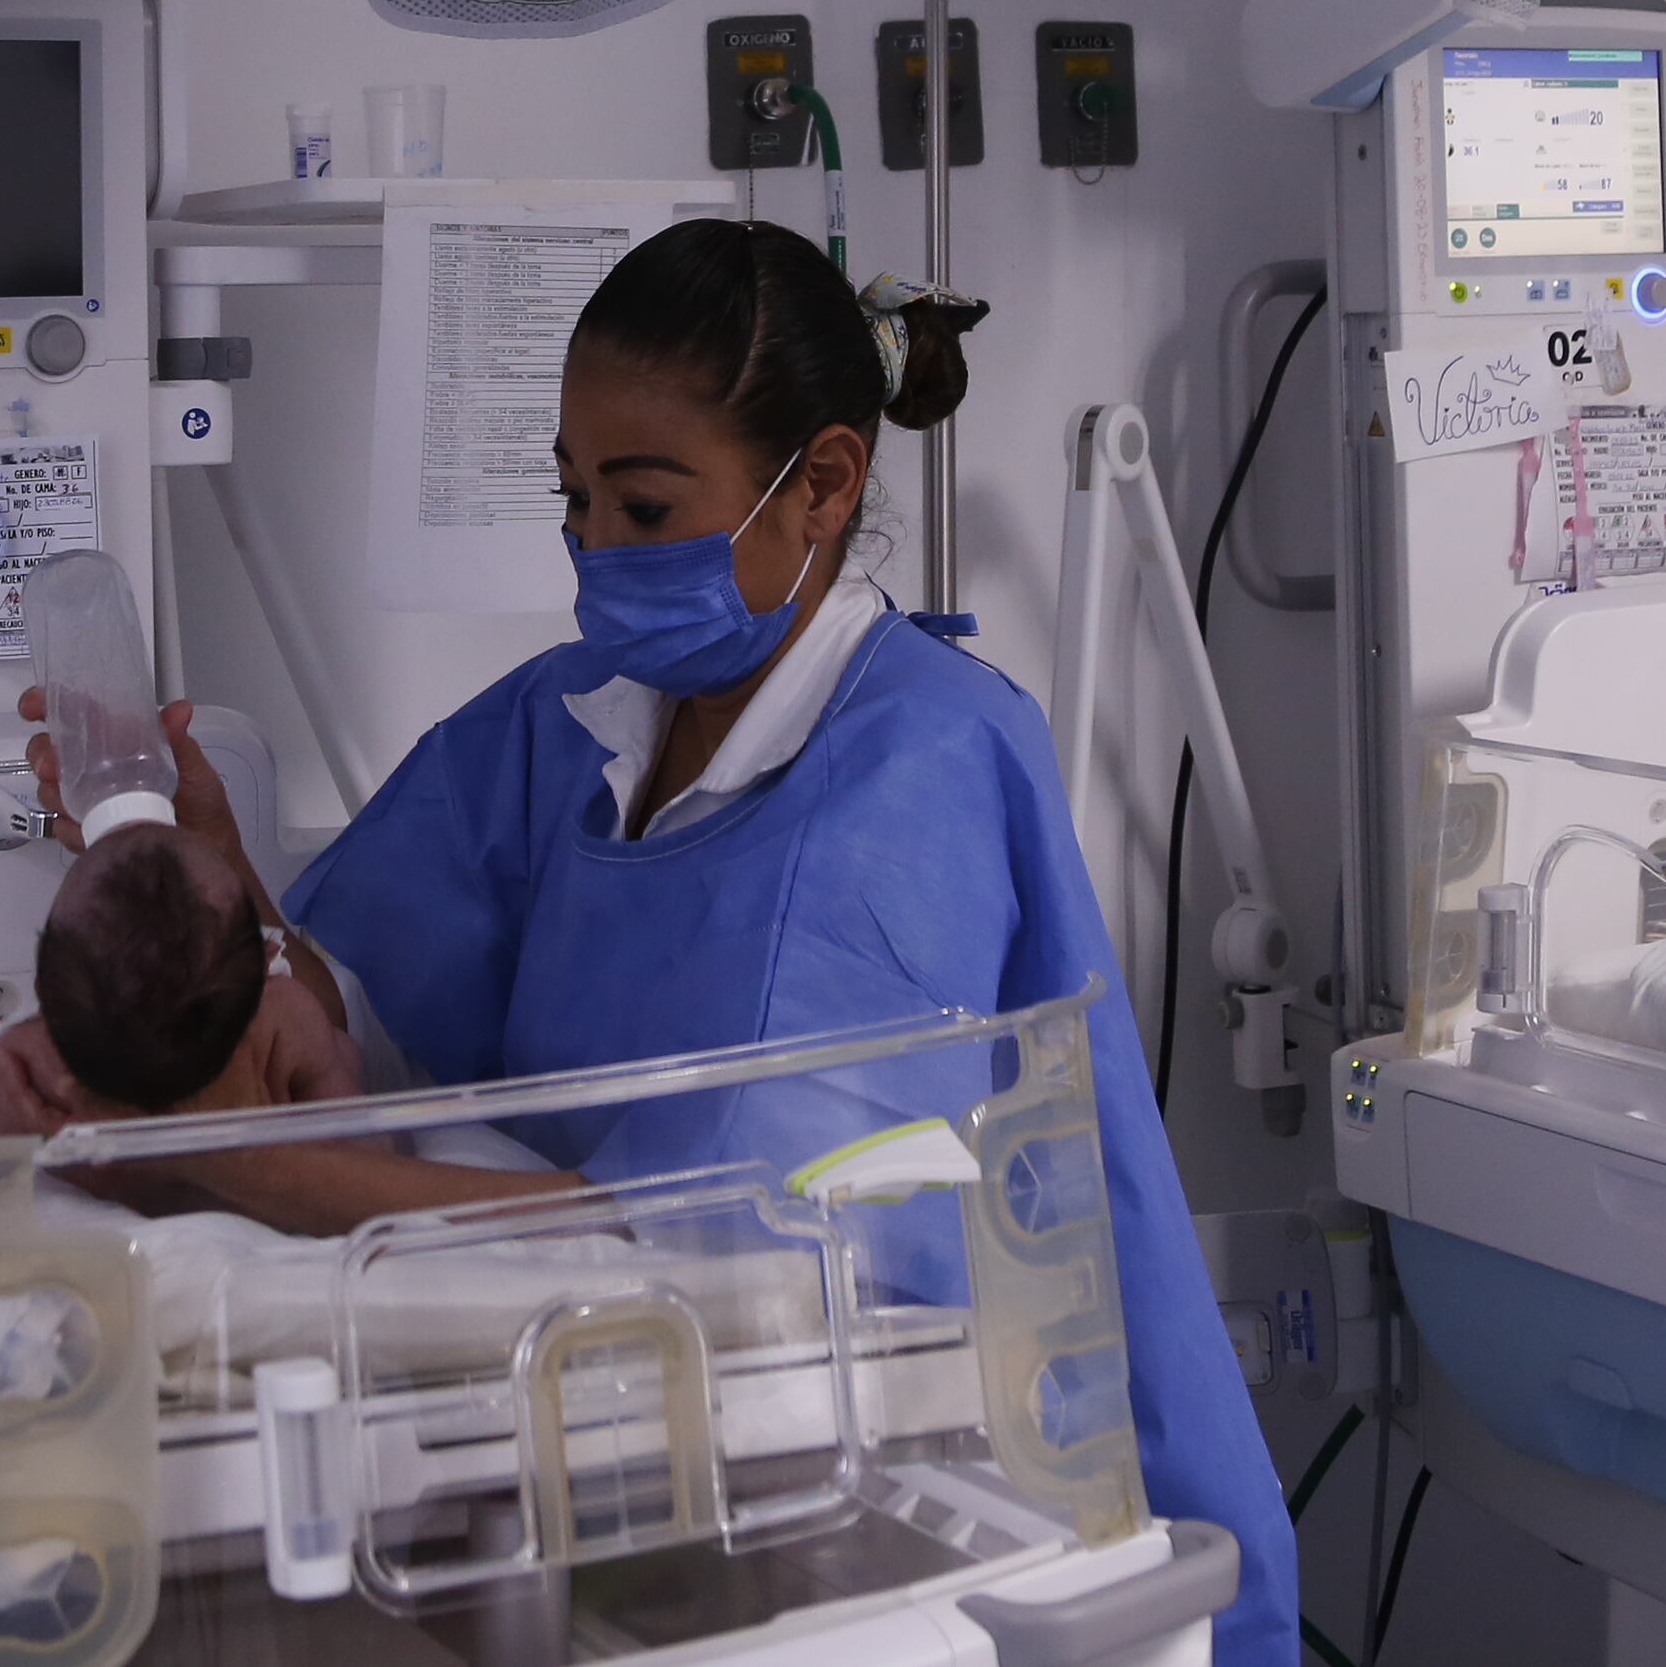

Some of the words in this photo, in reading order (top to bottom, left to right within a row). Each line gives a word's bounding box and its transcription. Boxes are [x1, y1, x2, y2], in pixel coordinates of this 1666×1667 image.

[730, 32, 790, 46] OXIGENO
[1590, 111, 1603, 126] 20
[1548, 329, 1592, 367] 02
[1405, 355, 1540, 446] Victoria
[14, 468, 47, 479] GENERO:
[6, 485, 18, 495] No.
[21, 484, 31, 494] DE
[35, 482, 57, 494] CAMA:
[13, 498, 32, 511] HIJO:
[20, 528, 34, 538] Y/O
[37, 527, 56, 538] PISO:
[12, 558, 22, 569] AL
